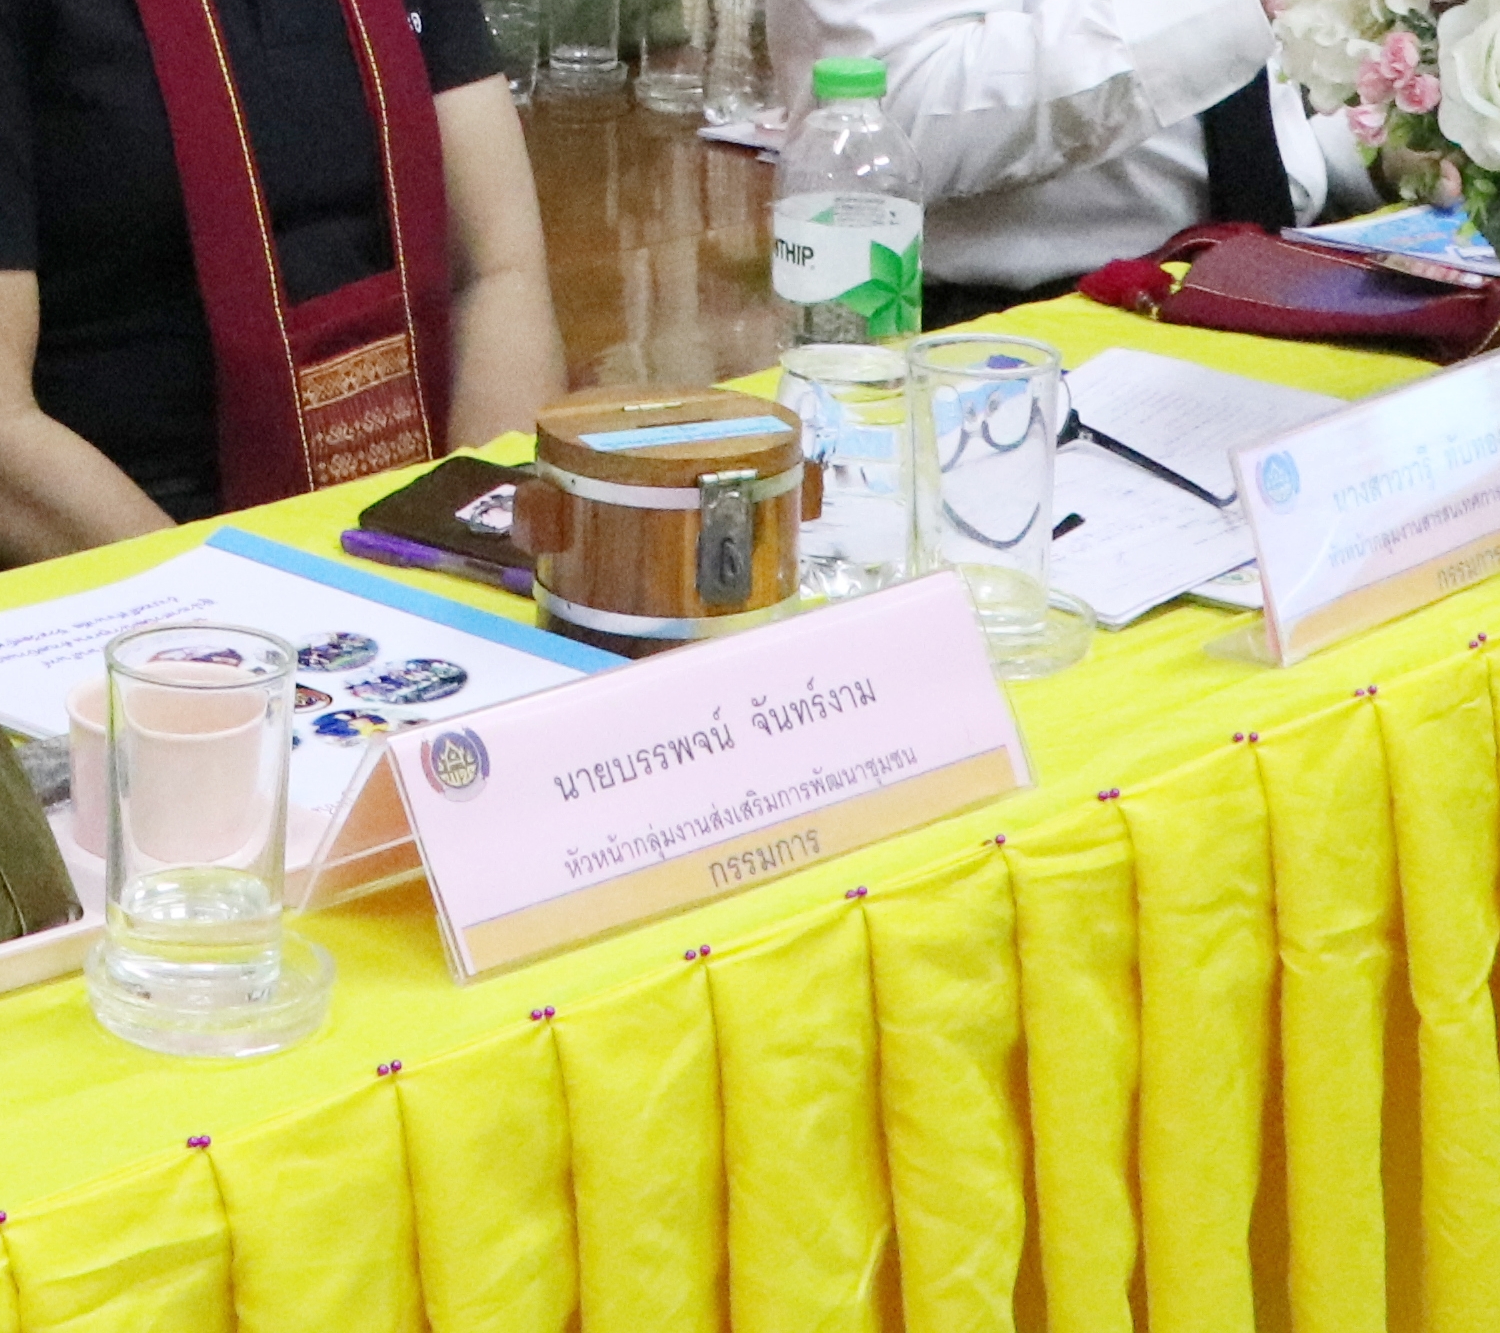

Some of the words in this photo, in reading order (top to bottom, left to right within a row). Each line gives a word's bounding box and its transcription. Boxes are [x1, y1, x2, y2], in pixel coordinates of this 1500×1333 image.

[553, 706, 737, 804] นายบรรพจน์
[749, 673, 879, 740] จันทร์งาม
[563, 744, 920, 882] หัวหน้ากลุ่มงานส่งเสริมการพัฒนาชุมชน
[707, 826, 824, 889] กรรมการ
